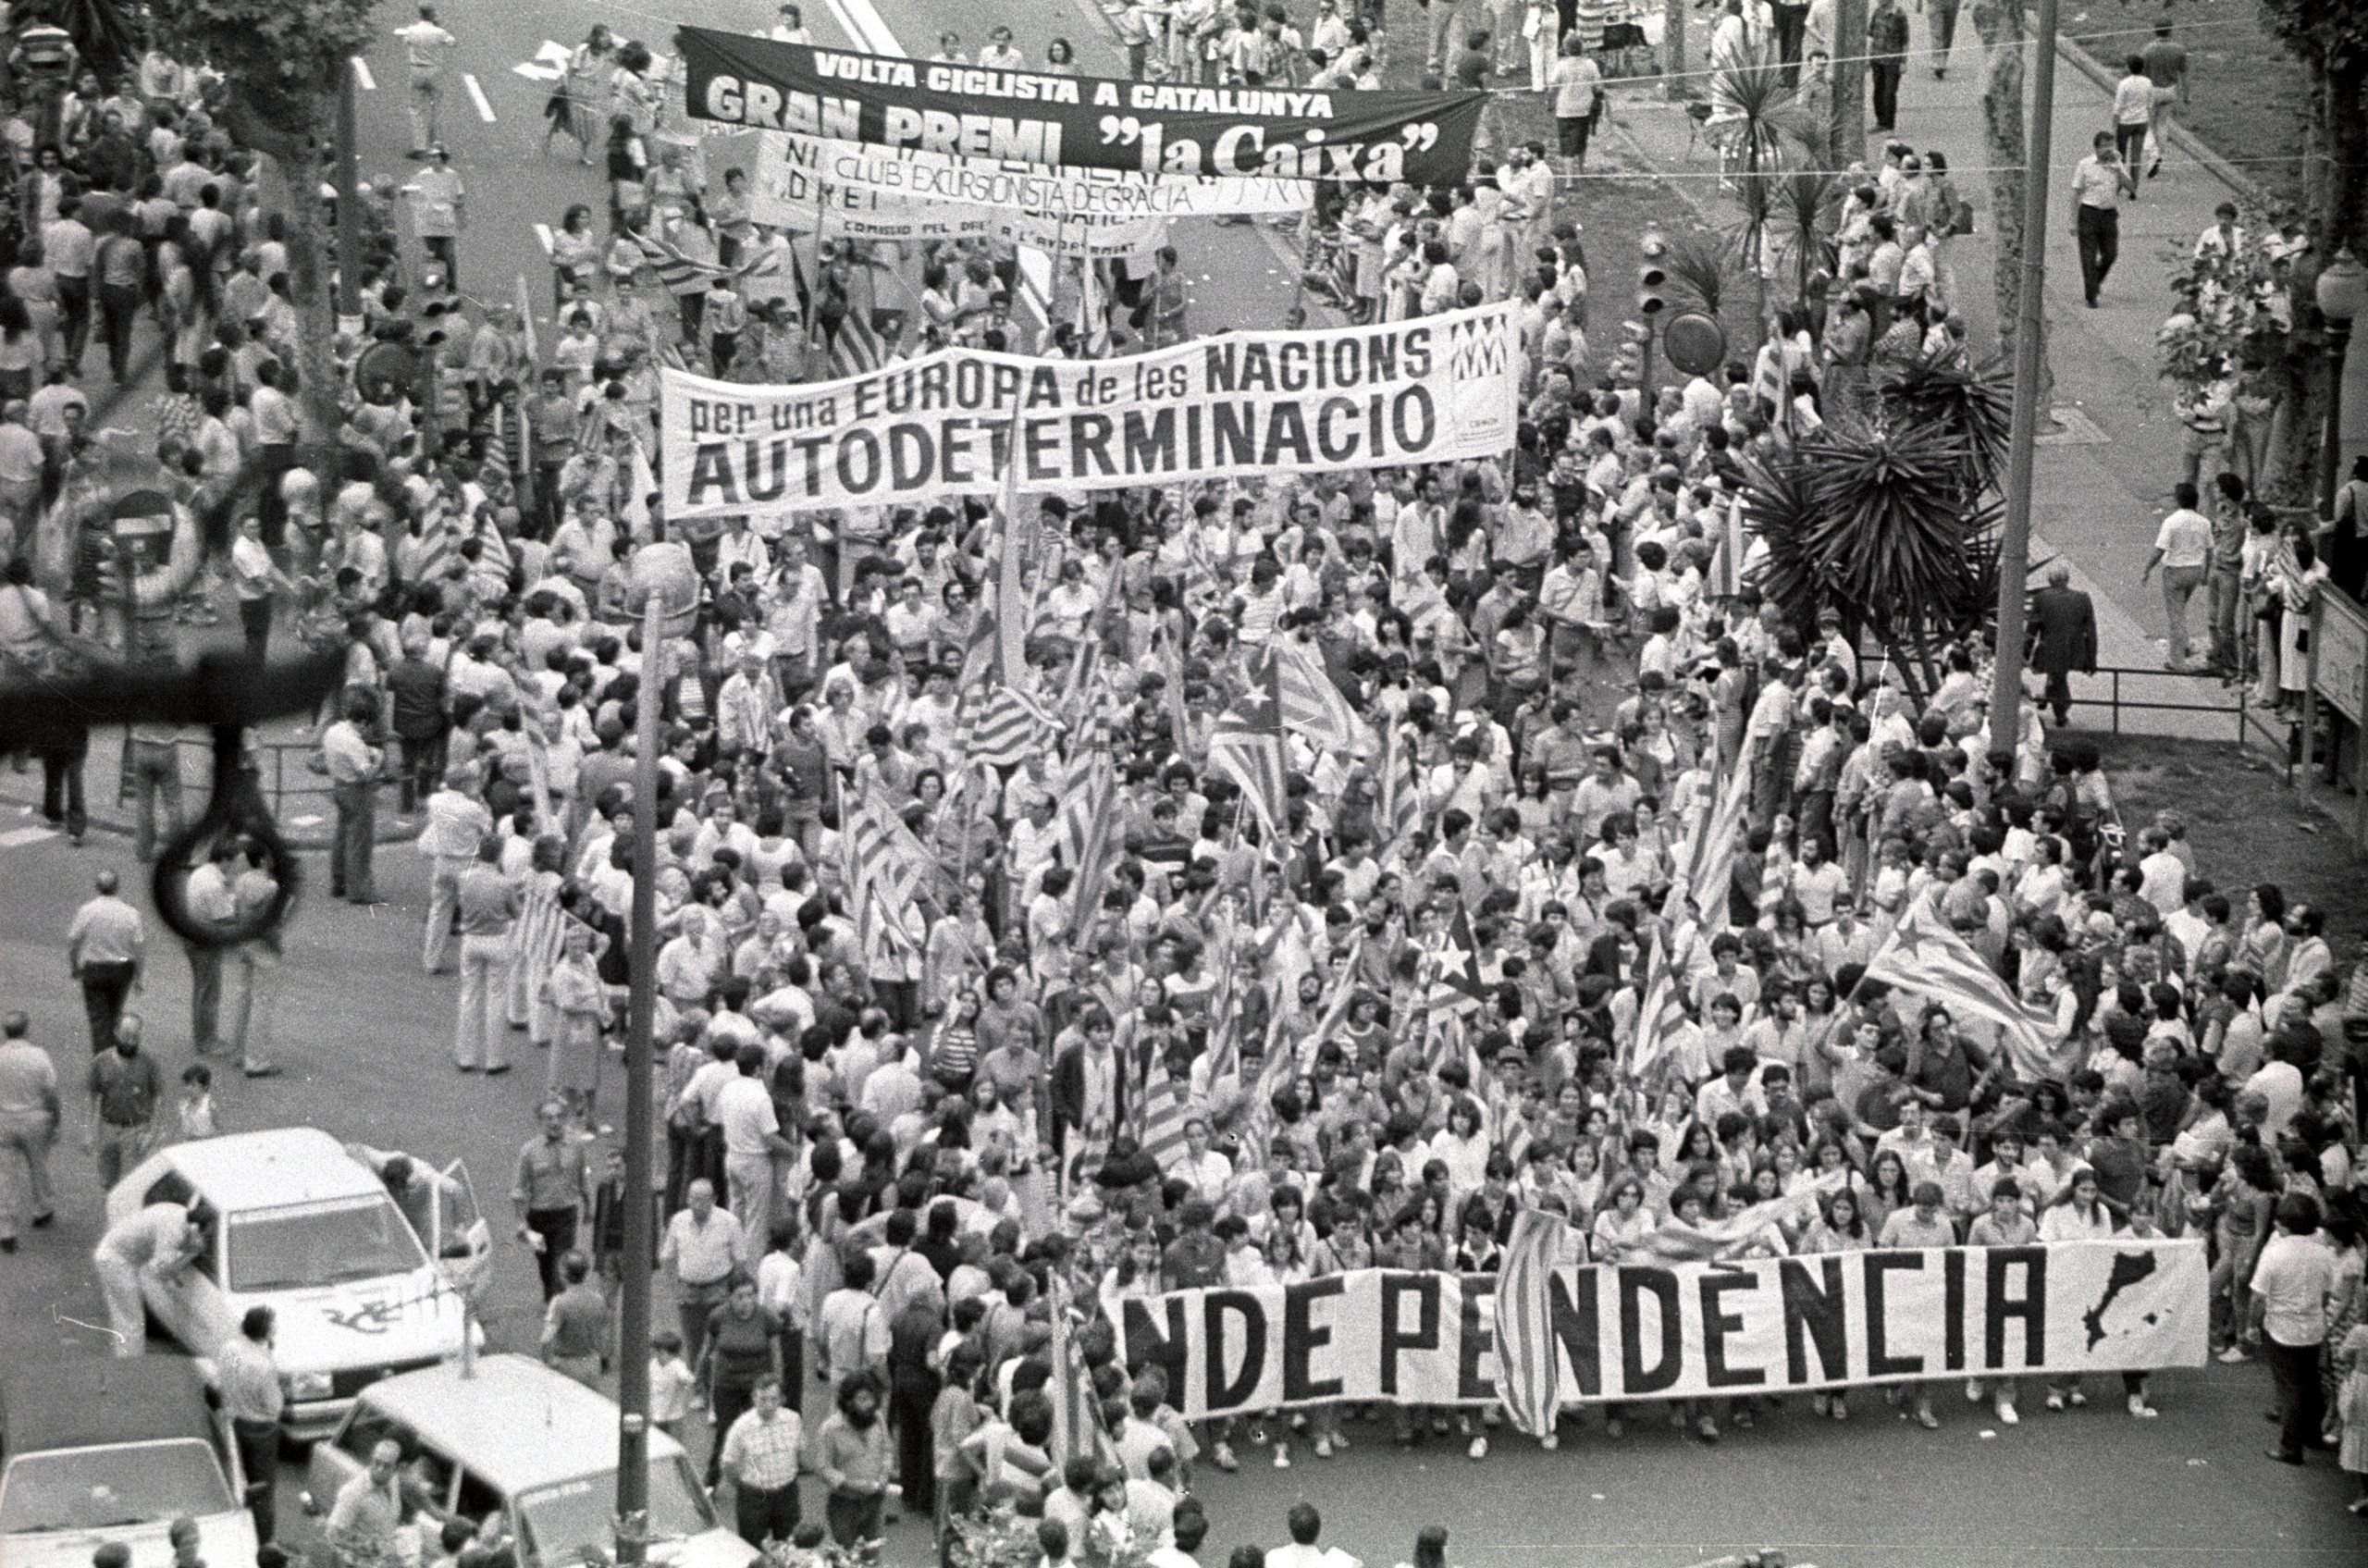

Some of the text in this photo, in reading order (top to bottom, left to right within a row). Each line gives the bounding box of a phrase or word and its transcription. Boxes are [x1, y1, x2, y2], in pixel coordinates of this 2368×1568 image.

[707, 75, 861, 139] GRAN
[884, 105, 1062, 165] PREMI
[814, 52, 1334, 118] VOLTA CICLISTA A CATALUNYA
[835, 156, 903, 186] CLUB
[691, 327, 1431, 441] per una EUROPA de les NACIONS
[687, 384, 1435, 504] AUTODETERMINACIO
